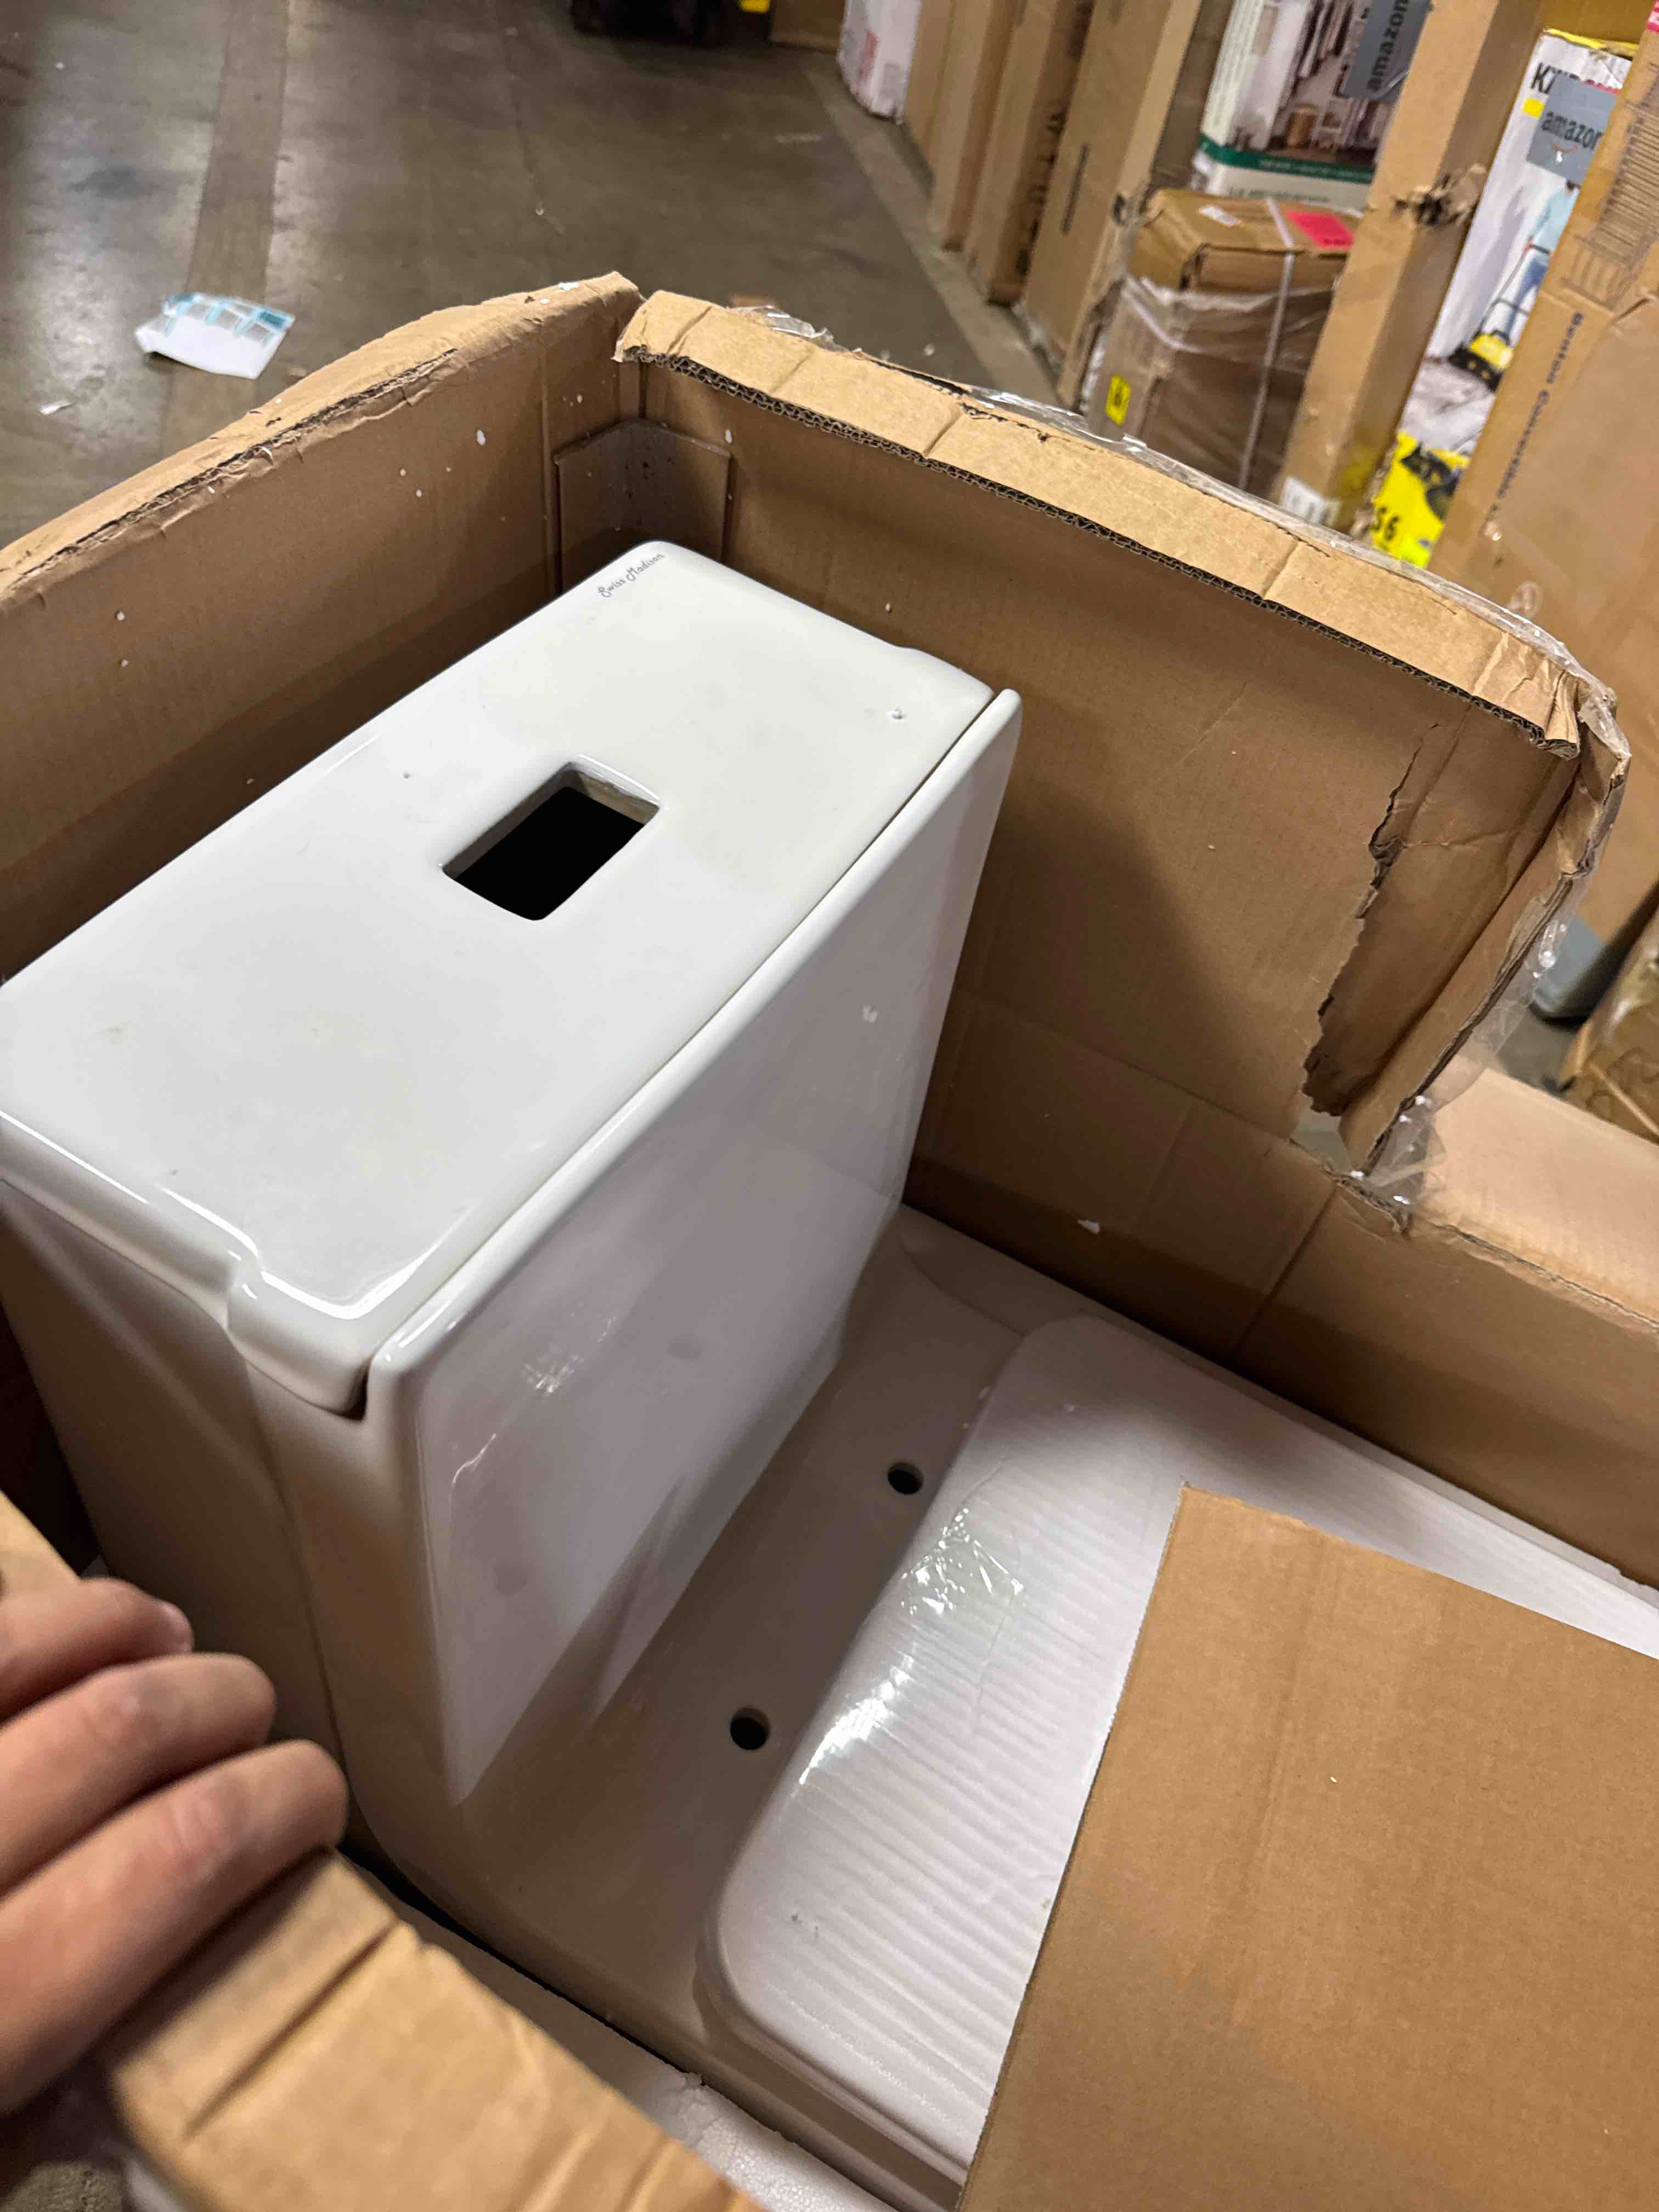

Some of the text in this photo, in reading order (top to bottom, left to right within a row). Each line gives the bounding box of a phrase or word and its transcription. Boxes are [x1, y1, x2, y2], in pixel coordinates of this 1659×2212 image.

[1367, 0, 1409, 92] amazon
[598, 554, 665, 597] Swiss Madison
